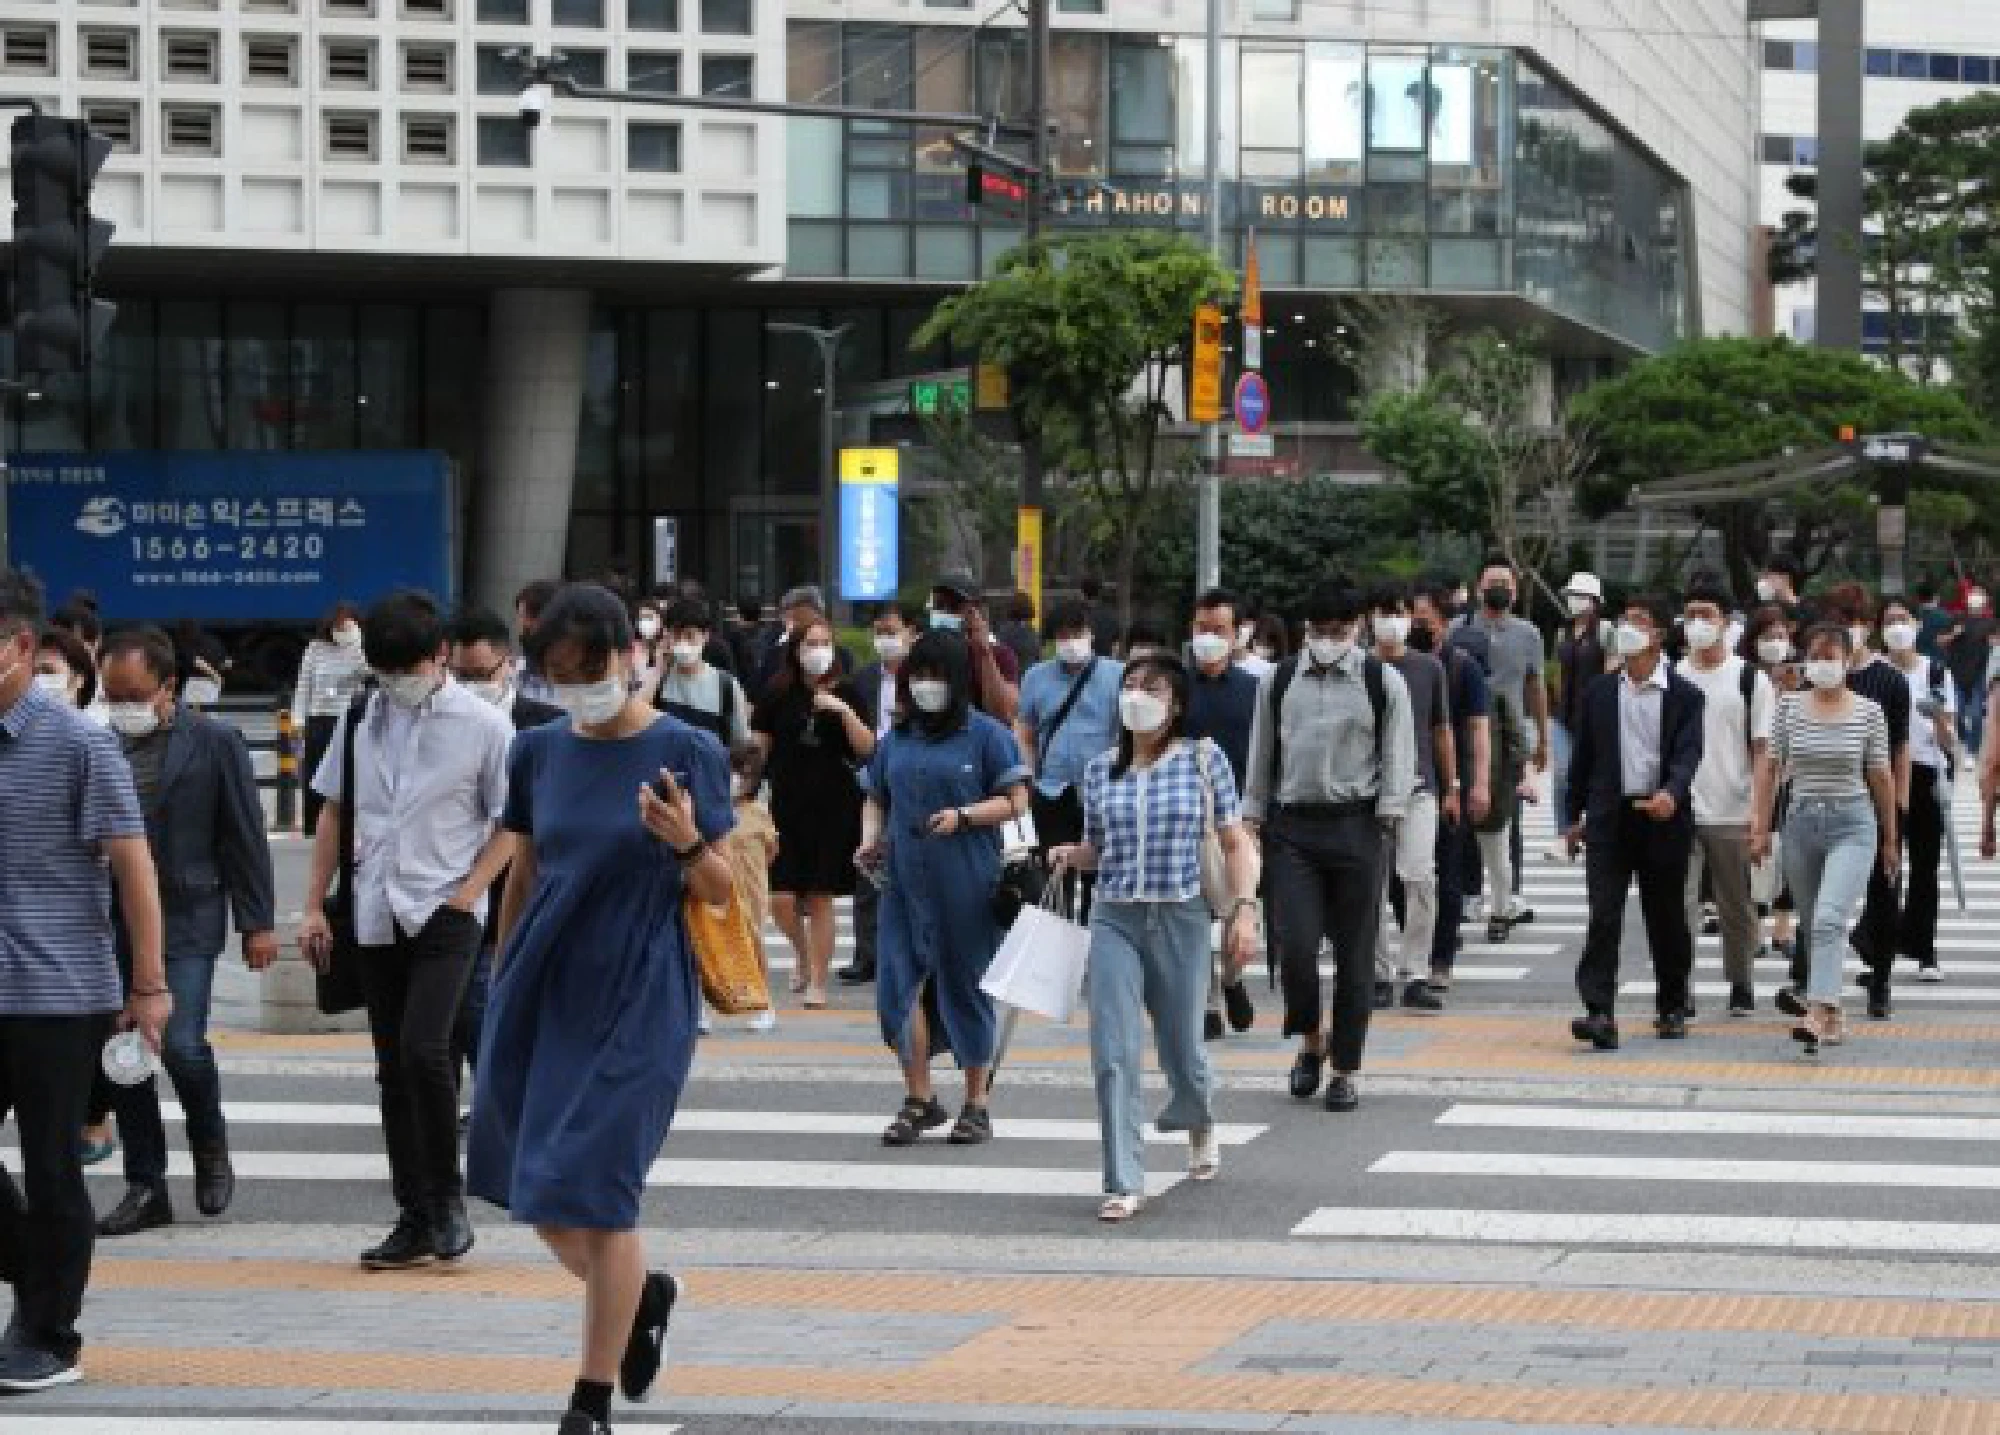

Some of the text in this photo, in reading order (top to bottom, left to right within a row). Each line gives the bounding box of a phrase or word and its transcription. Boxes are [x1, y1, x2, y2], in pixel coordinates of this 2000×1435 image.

[1053, 190, 1348, 219] HAHON ROOM
[132, 534, 323, 561] 1566-2420
